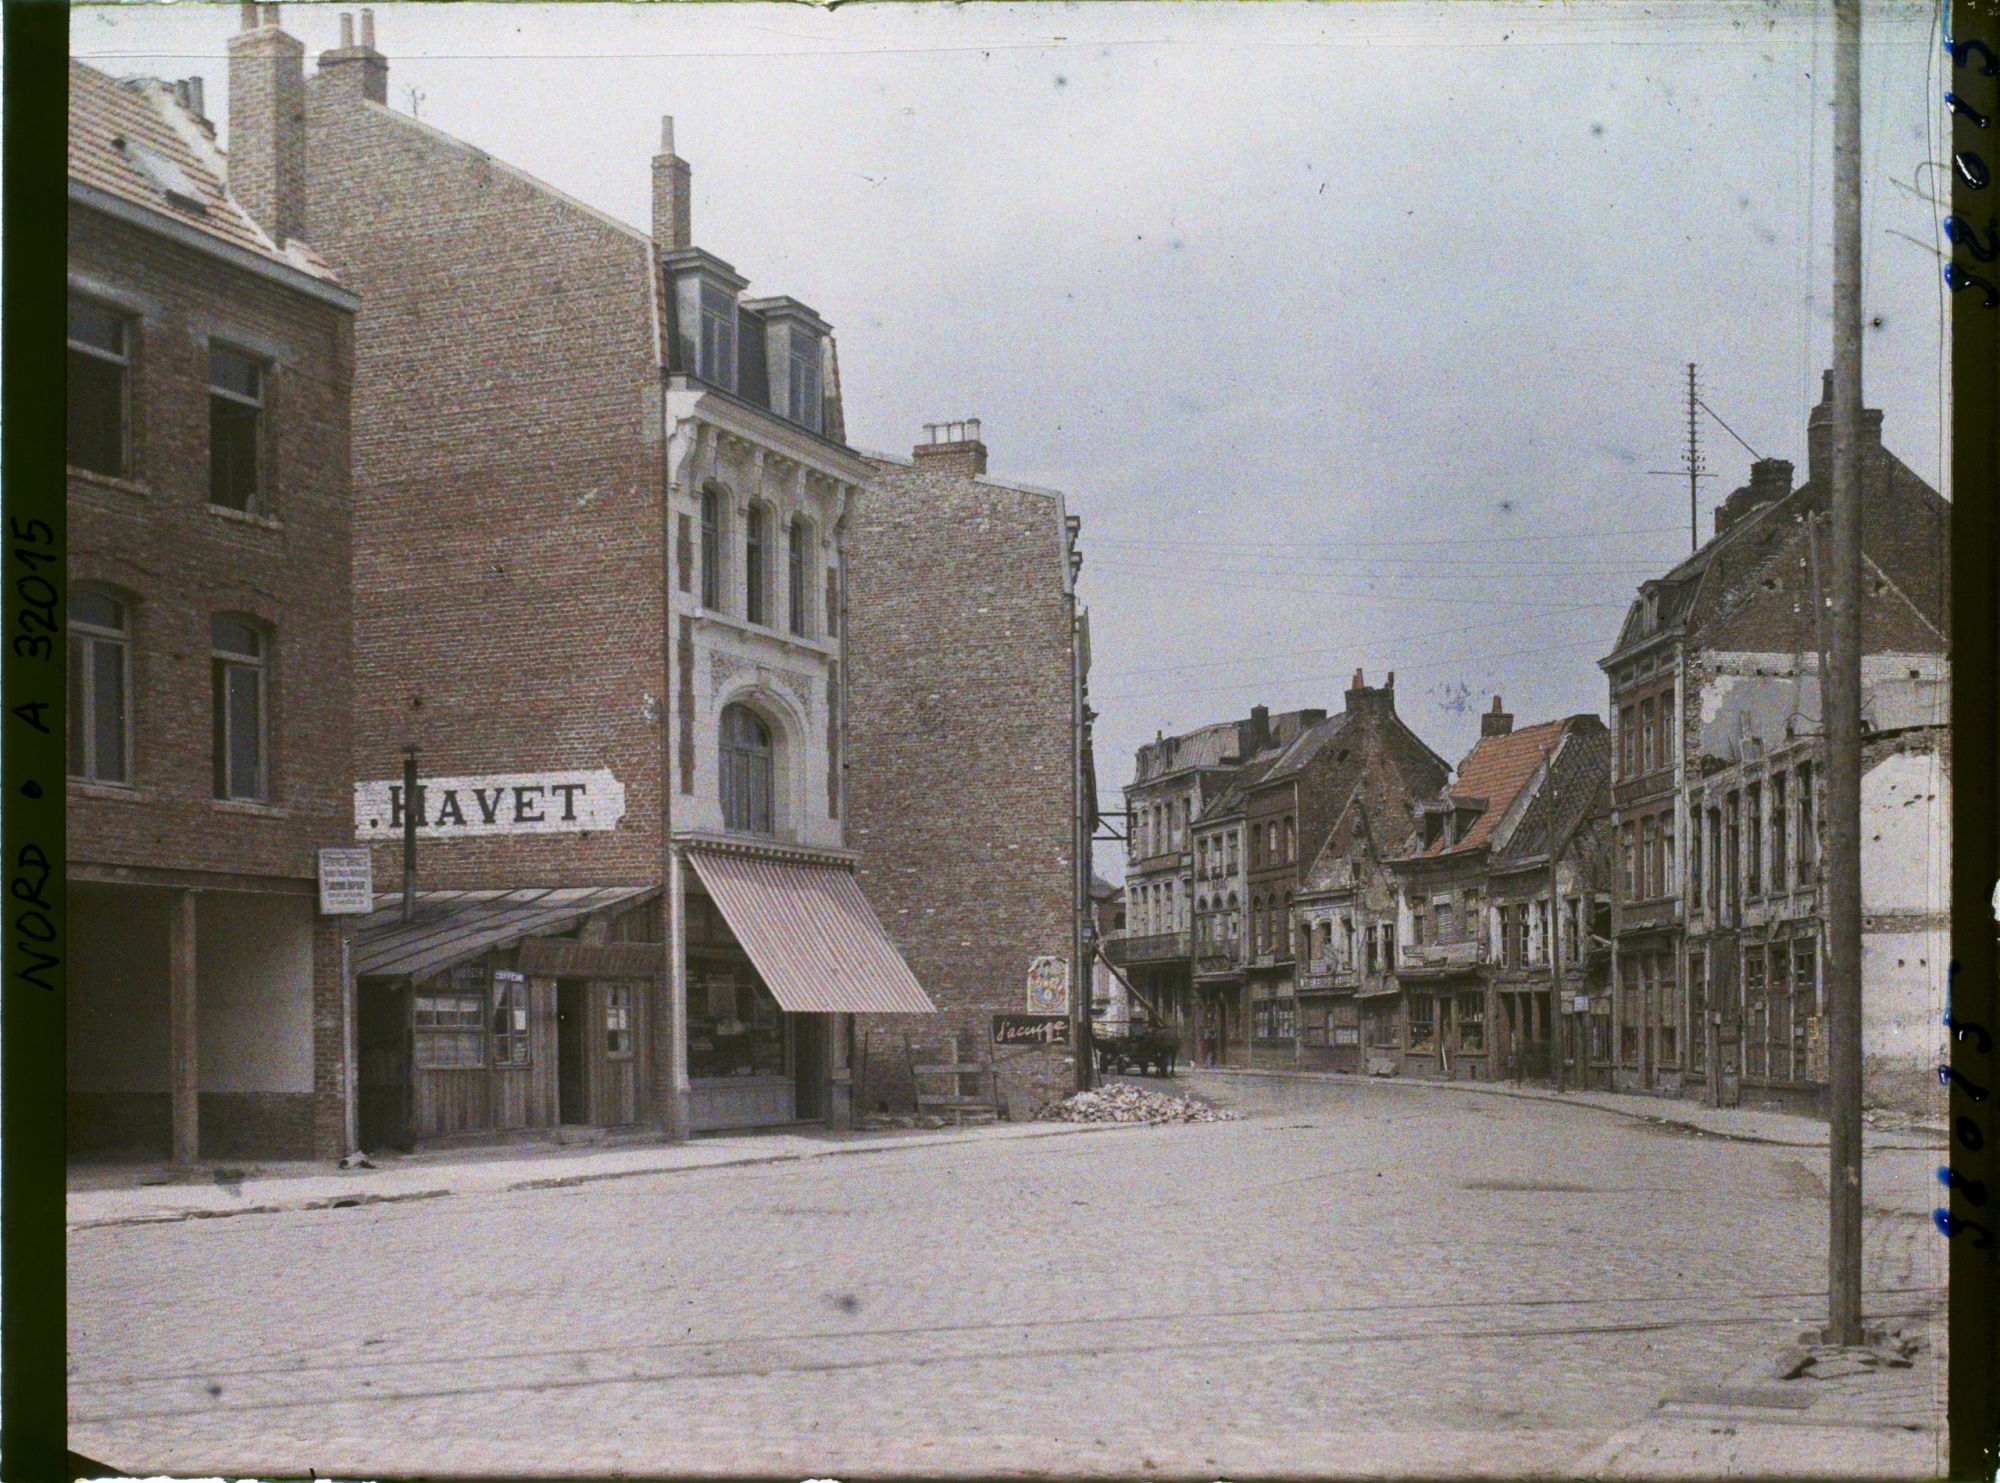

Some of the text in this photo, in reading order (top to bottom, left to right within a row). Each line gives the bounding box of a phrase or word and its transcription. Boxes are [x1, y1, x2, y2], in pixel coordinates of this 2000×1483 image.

[10, 515, 61, 991] NORD A 32015
[389, 783, 587, 828] HAVET
